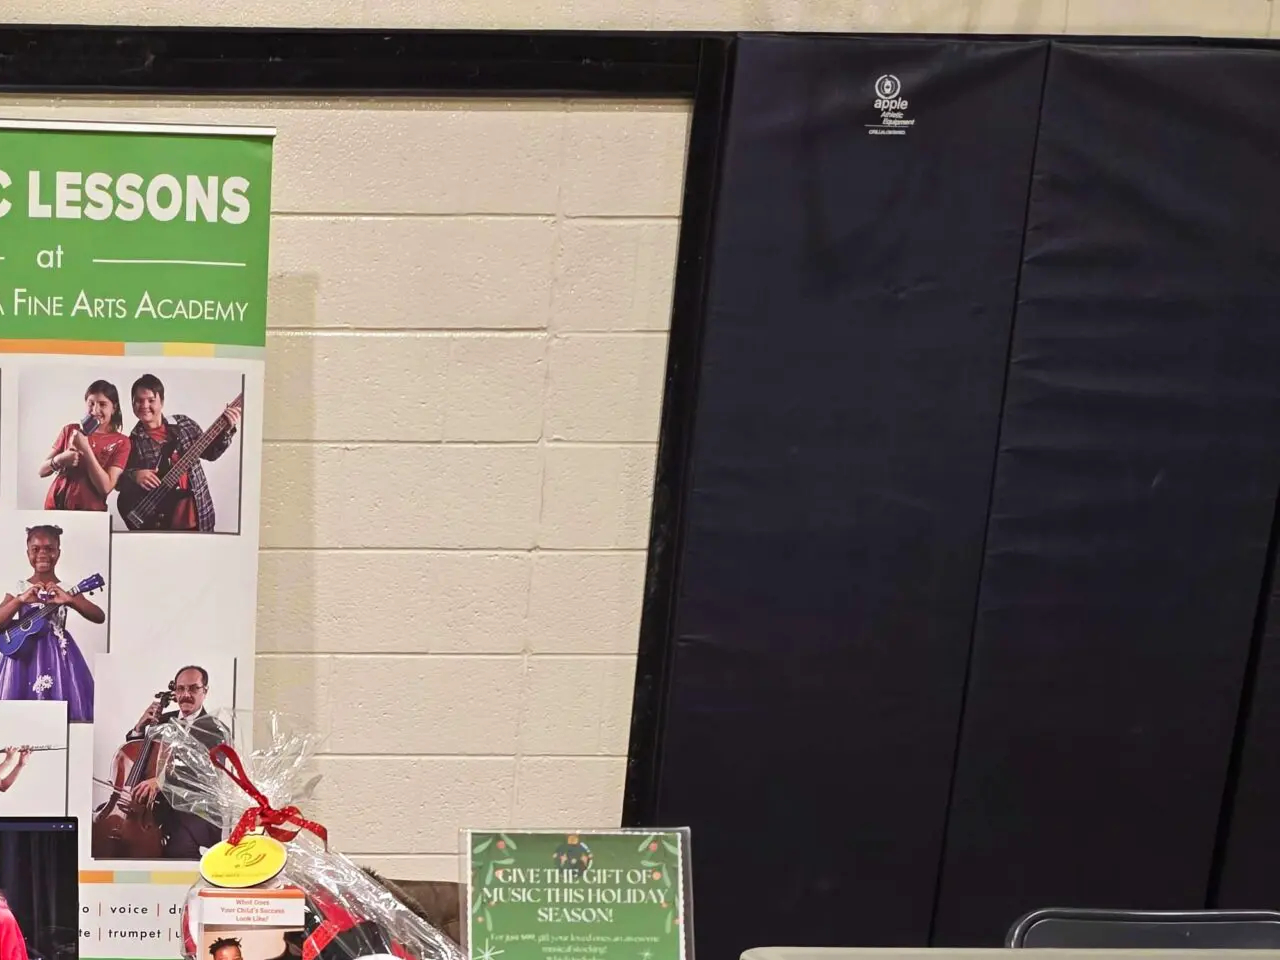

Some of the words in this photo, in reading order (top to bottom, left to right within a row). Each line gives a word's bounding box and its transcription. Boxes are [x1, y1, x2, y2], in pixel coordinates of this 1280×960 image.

[874, 97, 908, 111] apple
[28, 170, 250, 224] LESSONS
[36, 244, 64, 269] at
[13, 288, 63, 316] FINE
[70, 290, 127, 319] ARTS
[134, 291, 248, 322] ACADEMY
[498, 868, 541, 885] GIVE
[543, 868, 579, 885] THE
[582, 868, 624, 885] GIFT
[626, 868, 653, 885] OF
[483, 887, 541, 903] MUSIC
[543, 887, 585, 903] THIS
[587, 887, 668, 904] HOLIDAY
[110, 904, 149, 914] voice
[536, 907, 614, 923] SEASON!
[108, 929, 161, 941] trumpet
